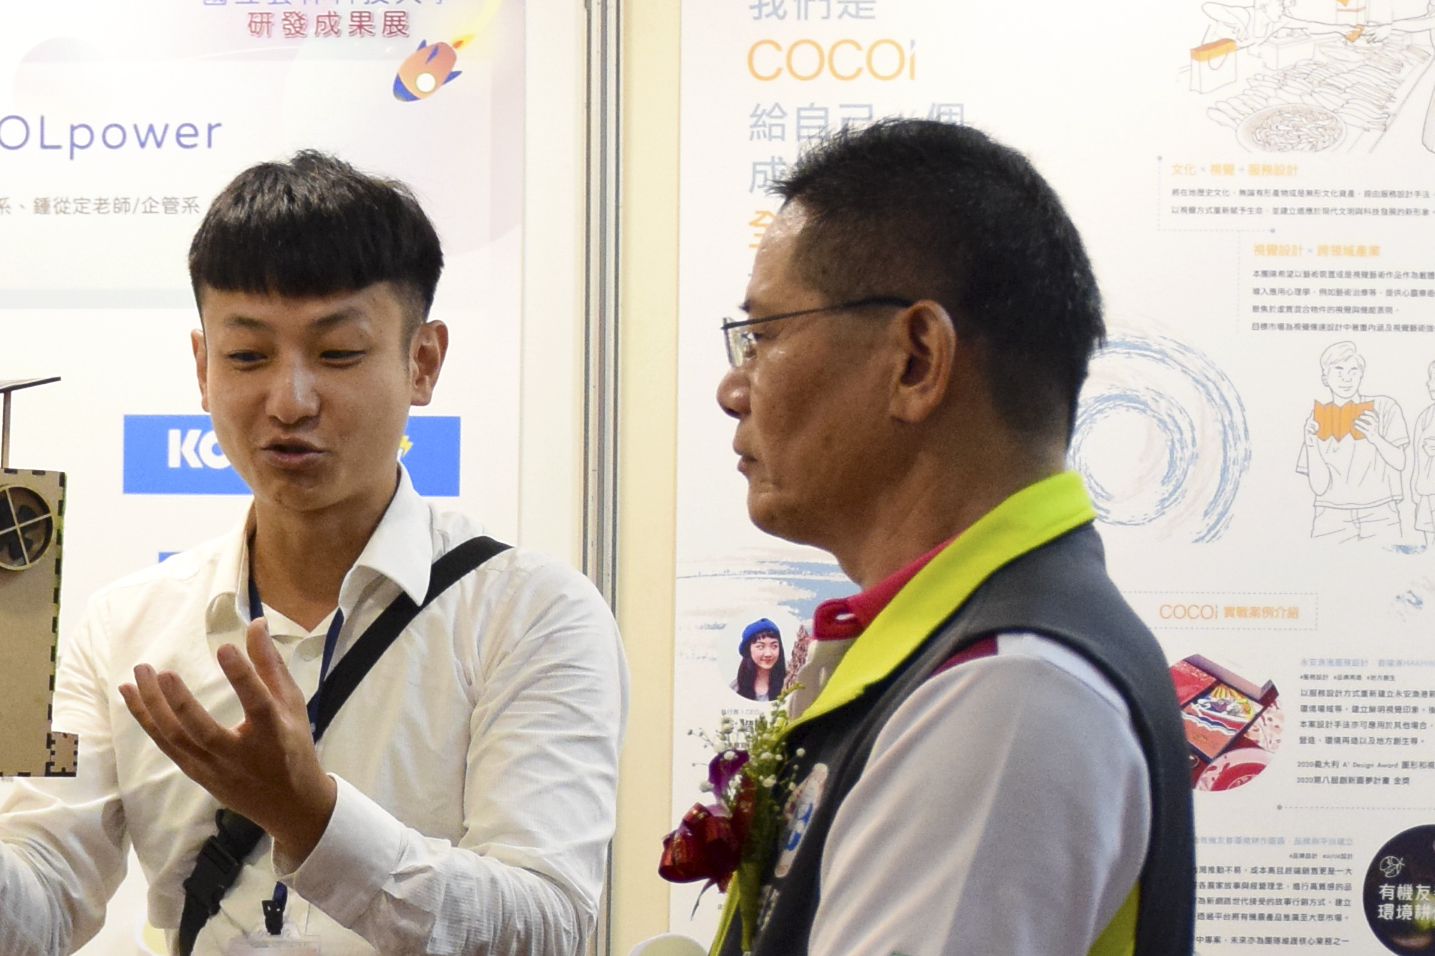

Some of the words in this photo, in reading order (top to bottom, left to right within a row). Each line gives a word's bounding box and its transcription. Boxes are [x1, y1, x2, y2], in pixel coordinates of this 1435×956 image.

[247, 10, 410, 39] 研發成果展
[747, 39, 916, 81] COCOi
[1159, 602, 1219, 620] COCOi
